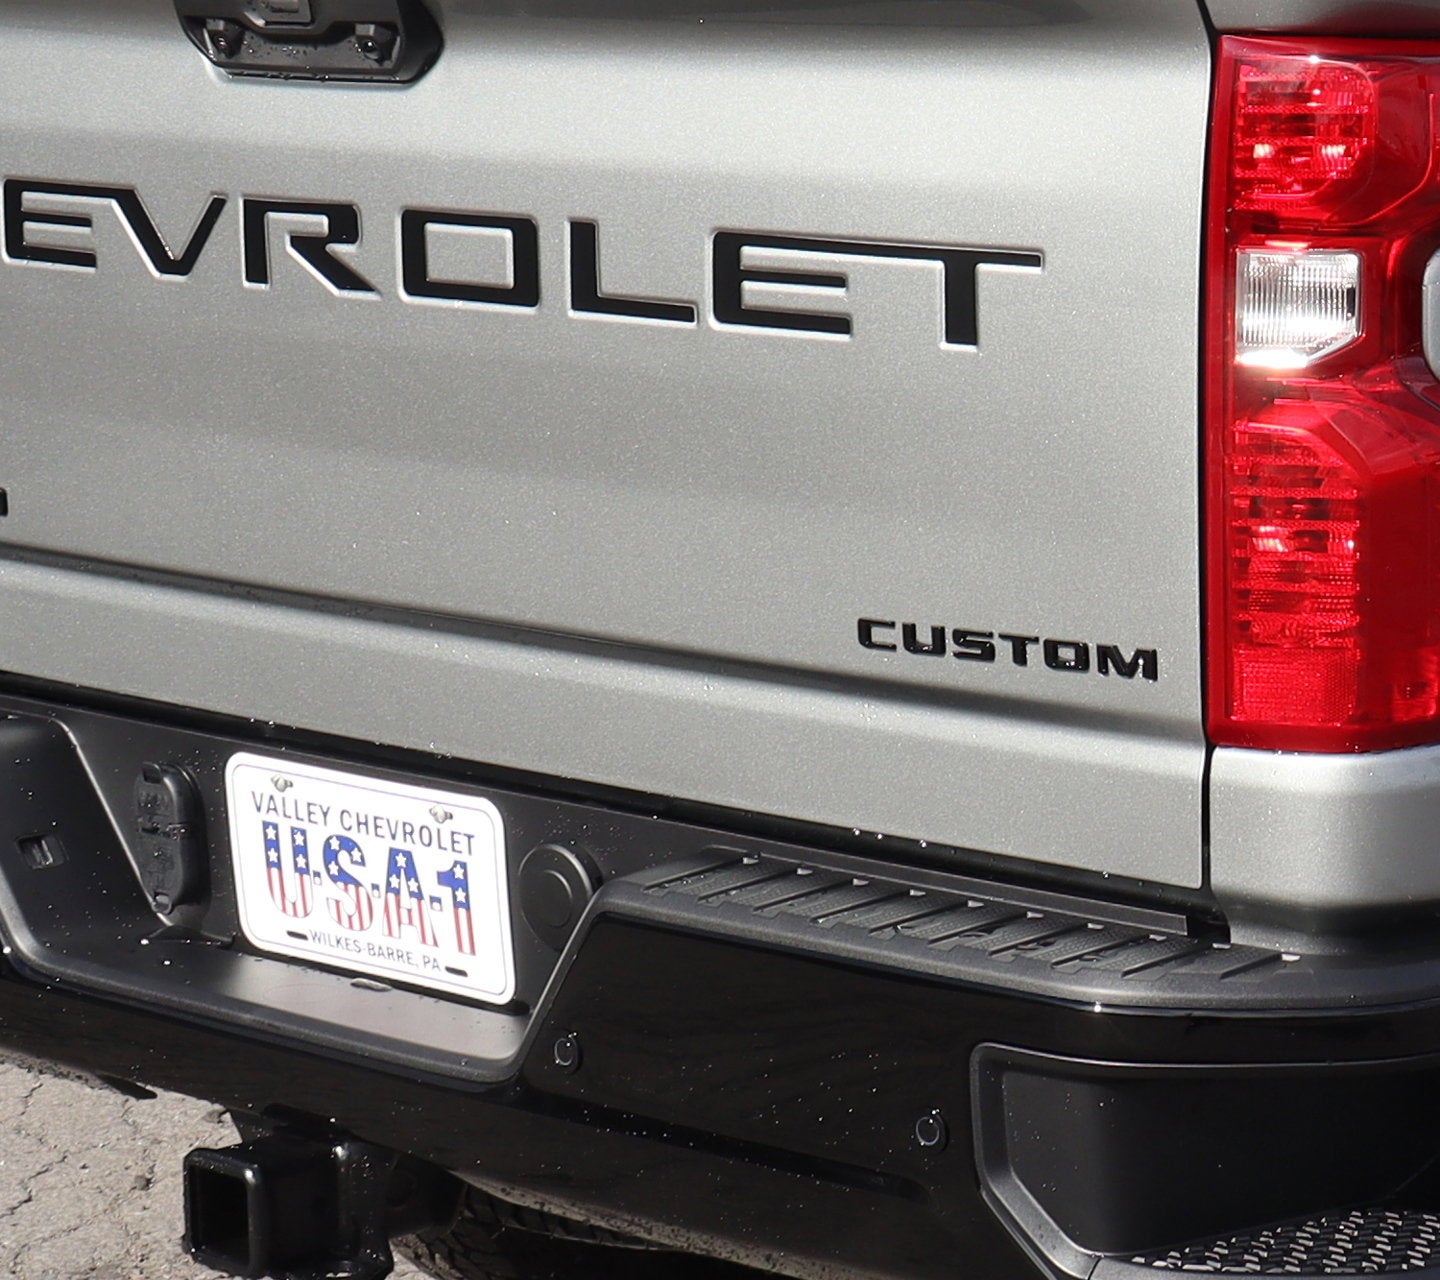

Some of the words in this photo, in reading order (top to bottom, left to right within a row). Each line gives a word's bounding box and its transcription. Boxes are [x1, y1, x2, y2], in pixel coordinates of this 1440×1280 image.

[857, 617, 1159, 682] CUSTOM
[251, 790, 332, 827] VALLEY
[340, 809, 475, 856] CHEVROLET
[309, 928, 420, 968] WILKES-BARRE,
[422, 955, 441, 971] PA
